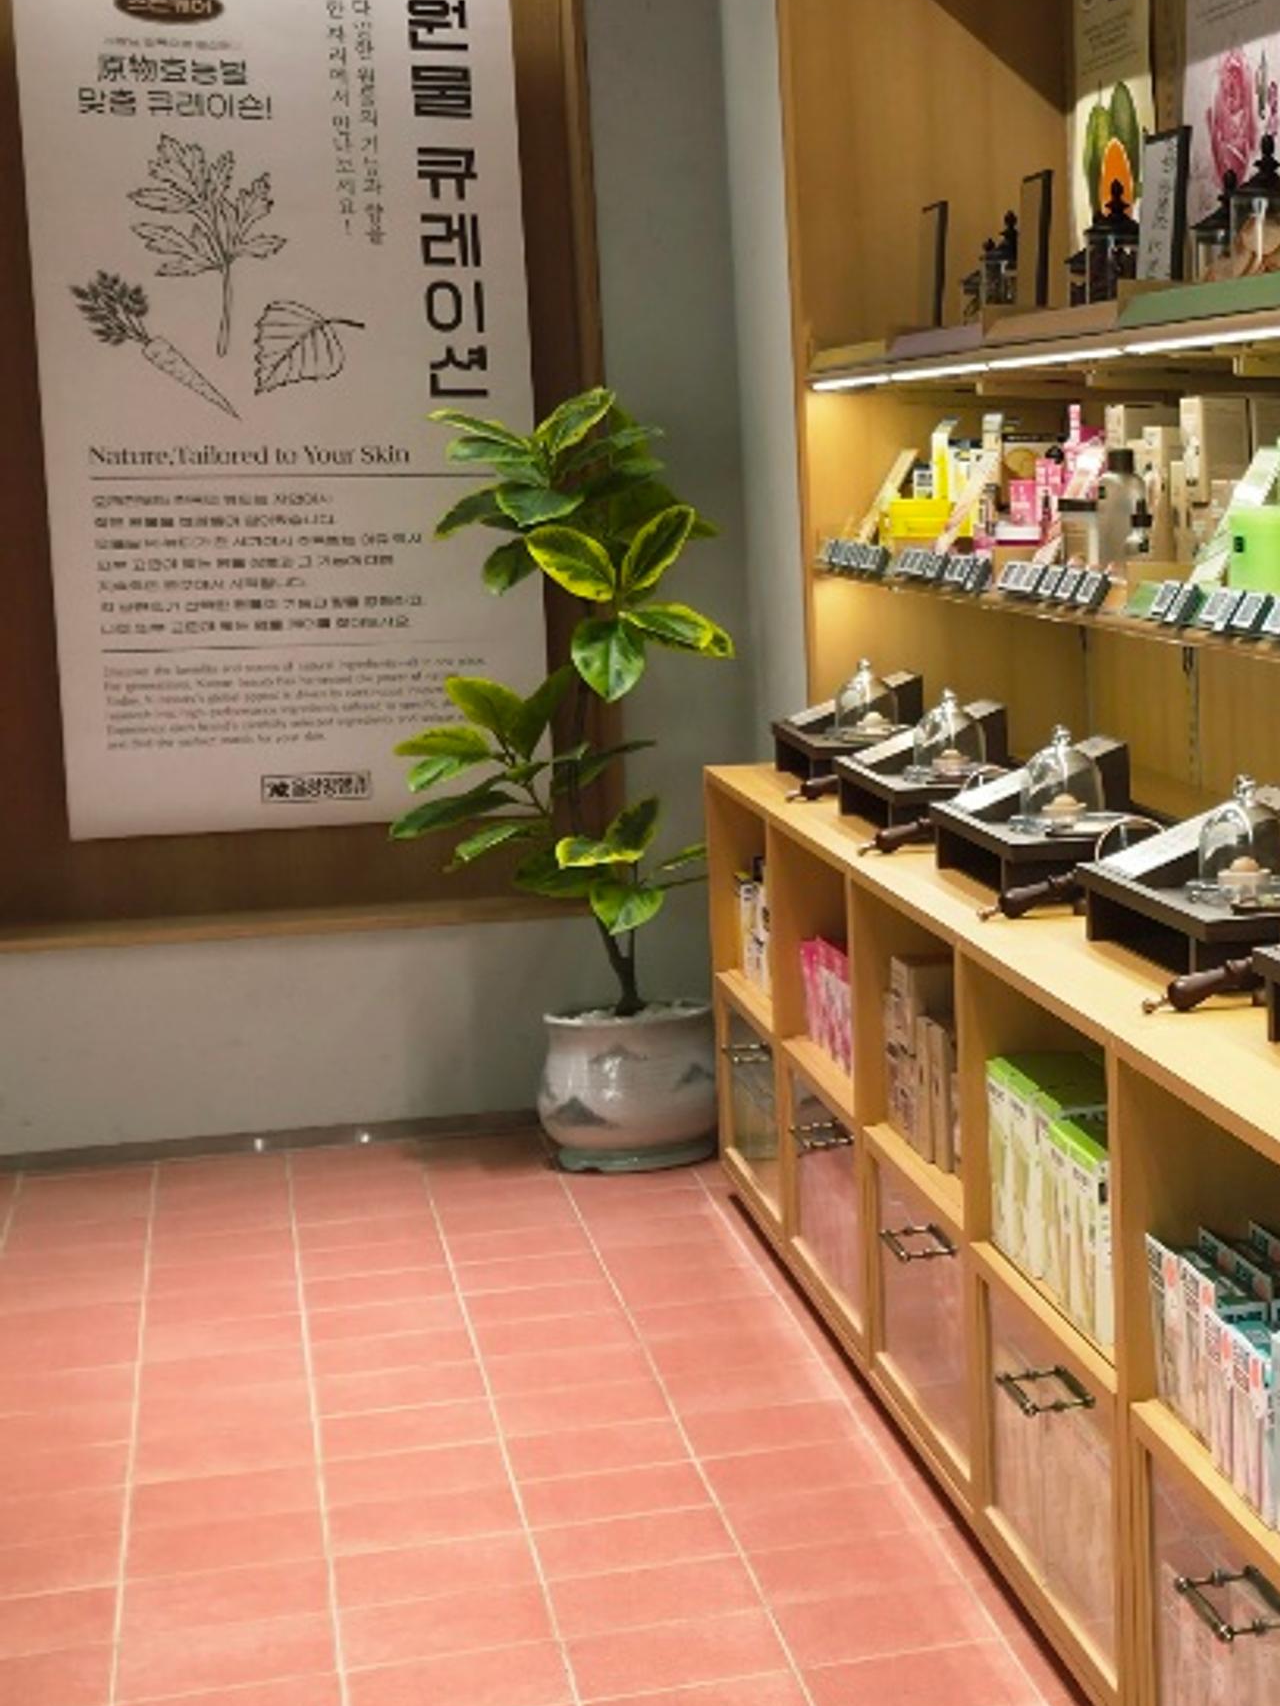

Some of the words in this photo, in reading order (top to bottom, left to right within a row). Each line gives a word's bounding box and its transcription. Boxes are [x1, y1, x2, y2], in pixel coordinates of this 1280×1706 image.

[415, 145, 491, 400] 큐레이션
[276, 446, 298, 466] to
[304, 445, 355, 466] Your
[360, 443, 411, 466] Skin
